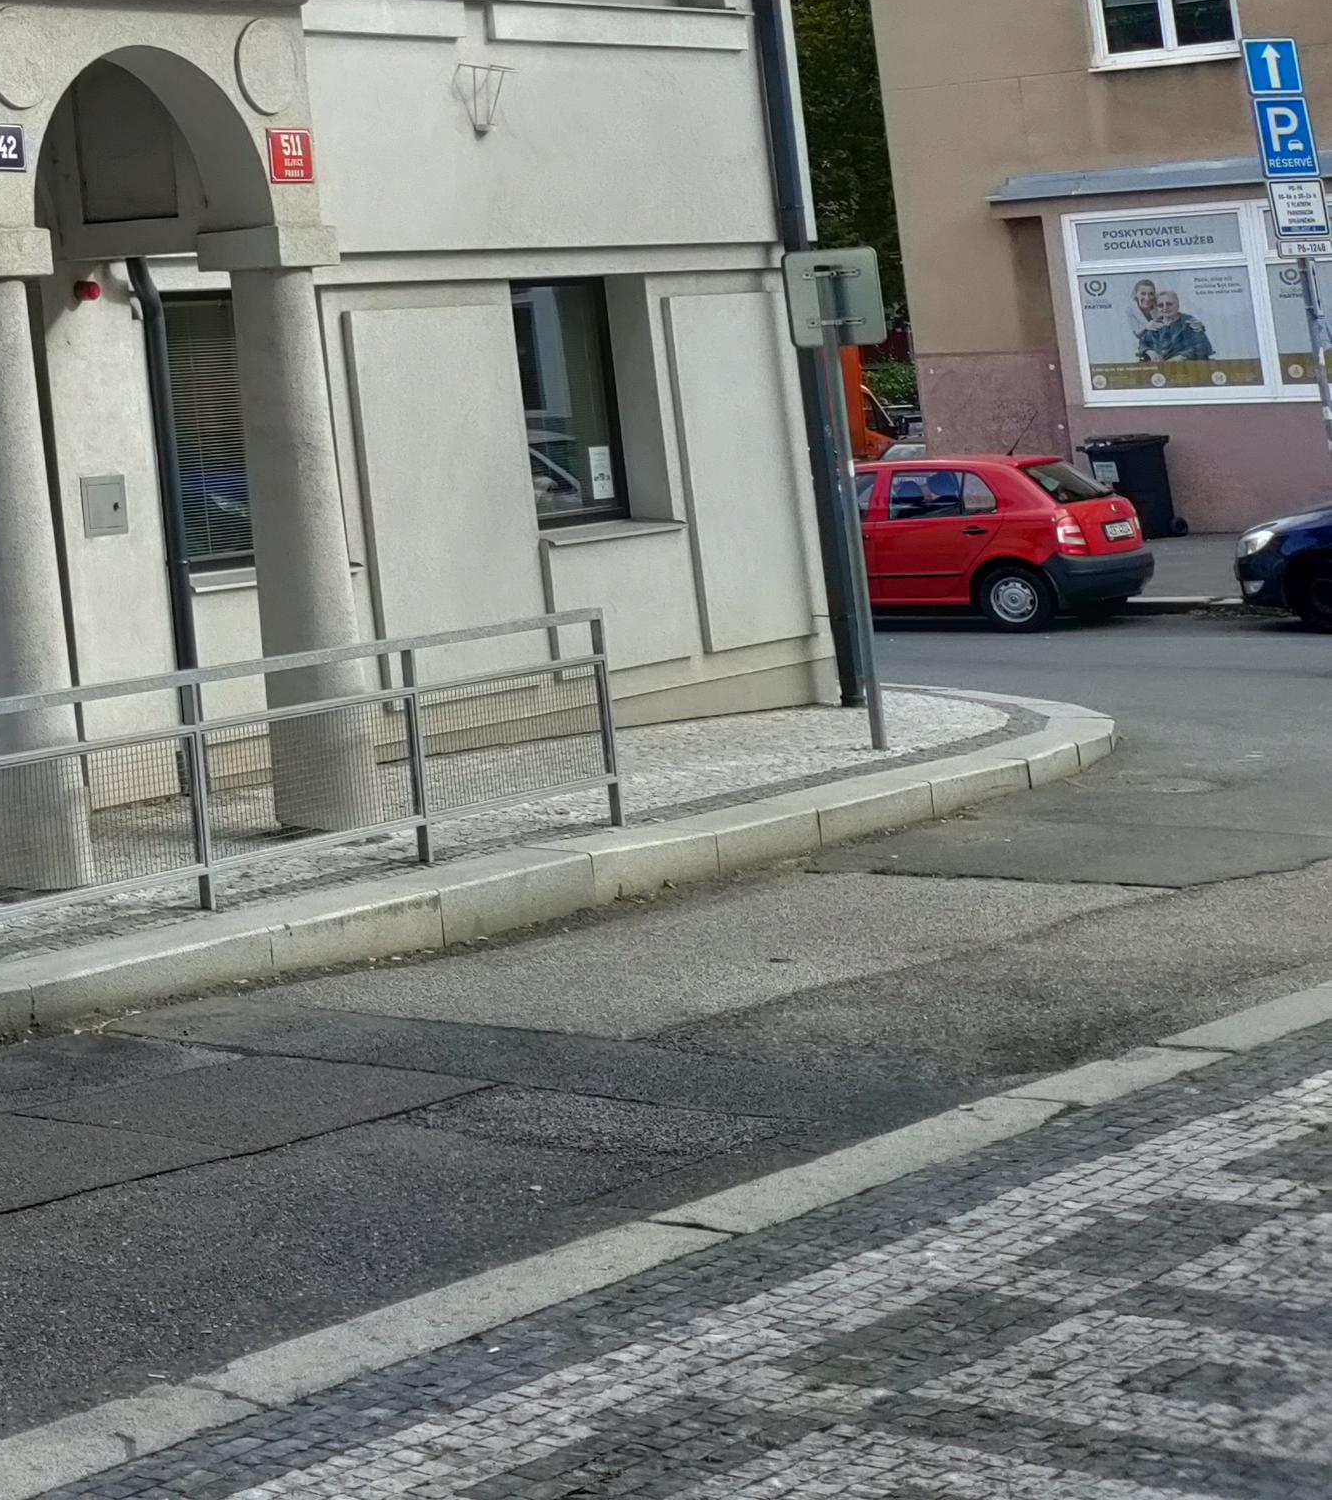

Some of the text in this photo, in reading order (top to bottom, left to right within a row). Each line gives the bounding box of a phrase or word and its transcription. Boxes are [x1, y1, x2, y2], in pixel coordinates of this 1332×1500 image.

[1266, 107, 1298, 152] P
[281, 134, 303, 156] 511
[1268, 156, 1313, 168] RÉSERVÉ
[1102, 225, 1187, 239] POSKYTOVATEL
[1104, 235, 1215, 251] SOCIÁLNÍCH SLUŽEB
